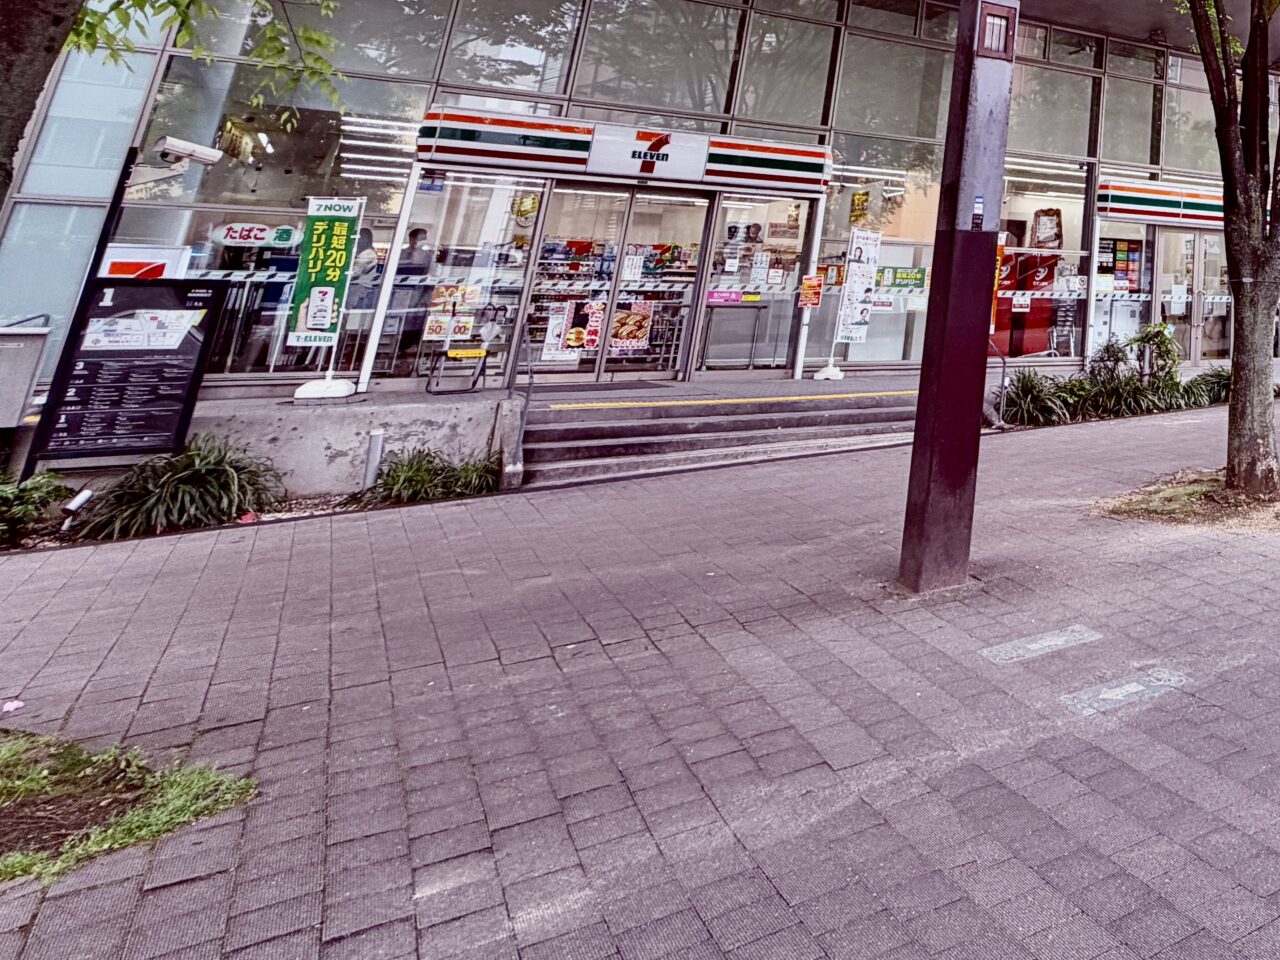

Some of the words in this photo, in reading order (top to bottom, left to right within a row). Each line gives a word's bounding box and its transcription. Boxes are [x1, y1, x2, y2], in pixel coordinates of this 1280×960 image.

[223, 226, 267, 241] たばこ
[273, 228, 294, 242] 酒
[308, 221, 329, 282] デリバリー
[325, 221, 349, 282] 最短20分
[98, 287, 115, 307] 1
